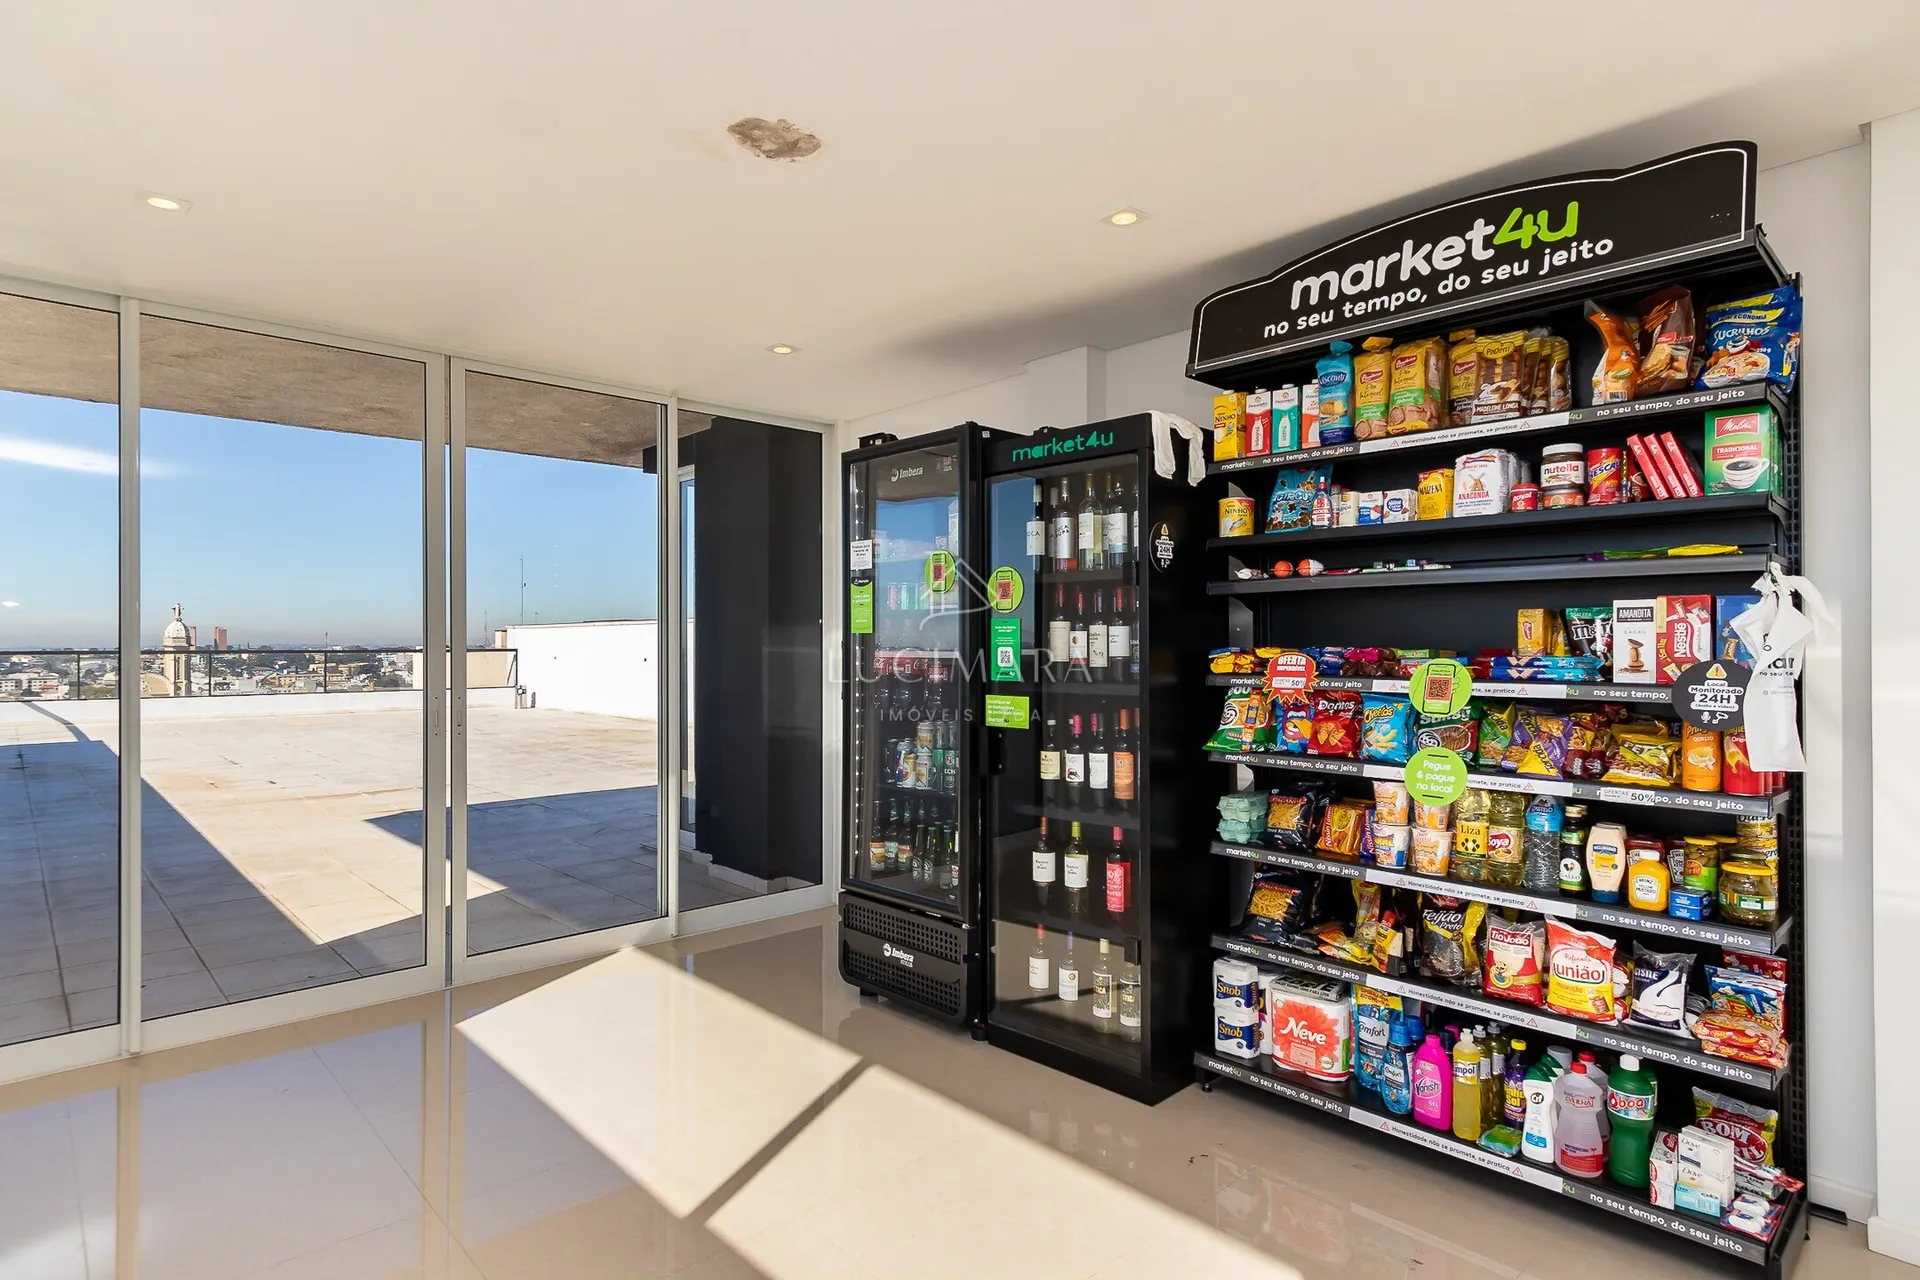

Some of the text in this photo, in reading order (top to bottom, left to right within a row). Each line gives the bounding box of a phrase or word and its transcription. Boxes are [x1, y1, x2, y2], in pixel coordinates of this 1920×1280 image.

[1291, 201, 1578, 310] market4u
[1264, 237, 1614, 338] no seu tempo, do seu jeito
[1713, 326, 1771, 346] SUCRILHOS
[1597, 389, 1745, 417] no seu tempo, do seu jeito
[1215, 413, 1236, 423] NINHO
[1401, 435, 1437, 445] Honestidade
[1438, 432, 1449, 440] não
[1458, 428, 1485, 438] promete,
[1495, 423, 1518, 432] pratica
[1012, 430, 1114, 462] market4u
[1716, 445, 1758, 454] TRADICIONAL
[1221, 460, 1255, 471] market4u
[1286, 452, 1309, 463] tempo,
[1335, 445, 1354, 455] jeito
[900, 466, 923, 479] Imbera
[1544, 464, 1579, 475] nutella
[1419, 484, 1443, 494] MAIZENA
[1458, 491, 1490, 500] ANACONDA
[1225, 507, 1248, 515] NINHO
[1618, 609, 1652, 619] AMANDITA
[1345, 680, 1362, 690] jeito
[1492, 687, 1515, 695] pratica
[1593, 689, 1607, 697] no
[1631, 689, 1669, 700] tempo,
[1699, 694, 1731, 704] 24H
[1318, 701, 1355, 714] Doritos
[1364, 706, 1394, 723] Cheetos
[1225, 754, 1258, 763] market4u
[1290, 758, 1314, 769] tempo,
[1315, 761, 1325, 769] do
[1326, 762, 1338, 771] seu
[1340, 763, 1358, 772] jeito
[1423, 760, 1452, 771] Pegue
[1426, 774, 1456, 784] pague
[1498, 780, 1521, 789] pratica
[1430, 783, 1453, 793] local
[1630, 792, 1655, 802] 50%
[1675, 796, 1743, 811] do seu jeito
[1460, 824, 1481, 836] Liza
[1226, 848, 1259, 859] market4u
[1291, 857, 1315, 869] tempo,
[1317, 861, 1326, 870] do
[1328, 864, 1340, 873] seu
[1341, 865, 1359, 876] jeito
[1408, 880, 1443, 893] Honestidade
[1444, 886, 1455, 895] não
[1464, 891, 1491, 902] promete,
[1501, 897, 1525, 906] pratica
[1422, 909, 1462, 925] Feijão
[1440, 921, 1463, 930] Preto
[1602, 913, 1751, 946] no seu tempo, do seu jeito
[892, 947, 914, 962] Imbera
[1226, 942, 1360, 981] market4u no seu tempo, do seu jeito
[1556, 963, 1601, 981] união
[1217, 984, 1241, 996] Snob
[1408, 988, 1444, 1003] Honestidade
[1445, 997, 1456, 1006] não
[1465, 1004, 1492, 1016] promete,
[1501, 1012, 1525, 1023] pratica
[1219, 1025, 1243, 1038] Snob
[1280, 1017, 1327, 1045] Neve
[1358, 1020, 1386, 1037] Comfort
[1604, 1036, 1753, 1080] no seu tempo, do seu jeito
[1208, 1060, 1343, 1113] market4u no seu tempo, do seu jeito
[1415, 1081, 1440, 1096] Vanish
[1428, 1100, 1439, 1108] GEL
[1702, 1121, 1750, 1144] BOM
[1391, 1126, 1428, 1143] Honestidade
[1429, 1138, 1440, 1147] não
[1449, 1145, 1477, 1161] promete,
[1486, 1158, 1510, 1171] pratica
[1681, 1137, 1701, 1149] Dove
[1682, 1167, 1703, 1178] Dove
[1590, 1192, 1743, 1253] no seu tempo, do seu jeito
